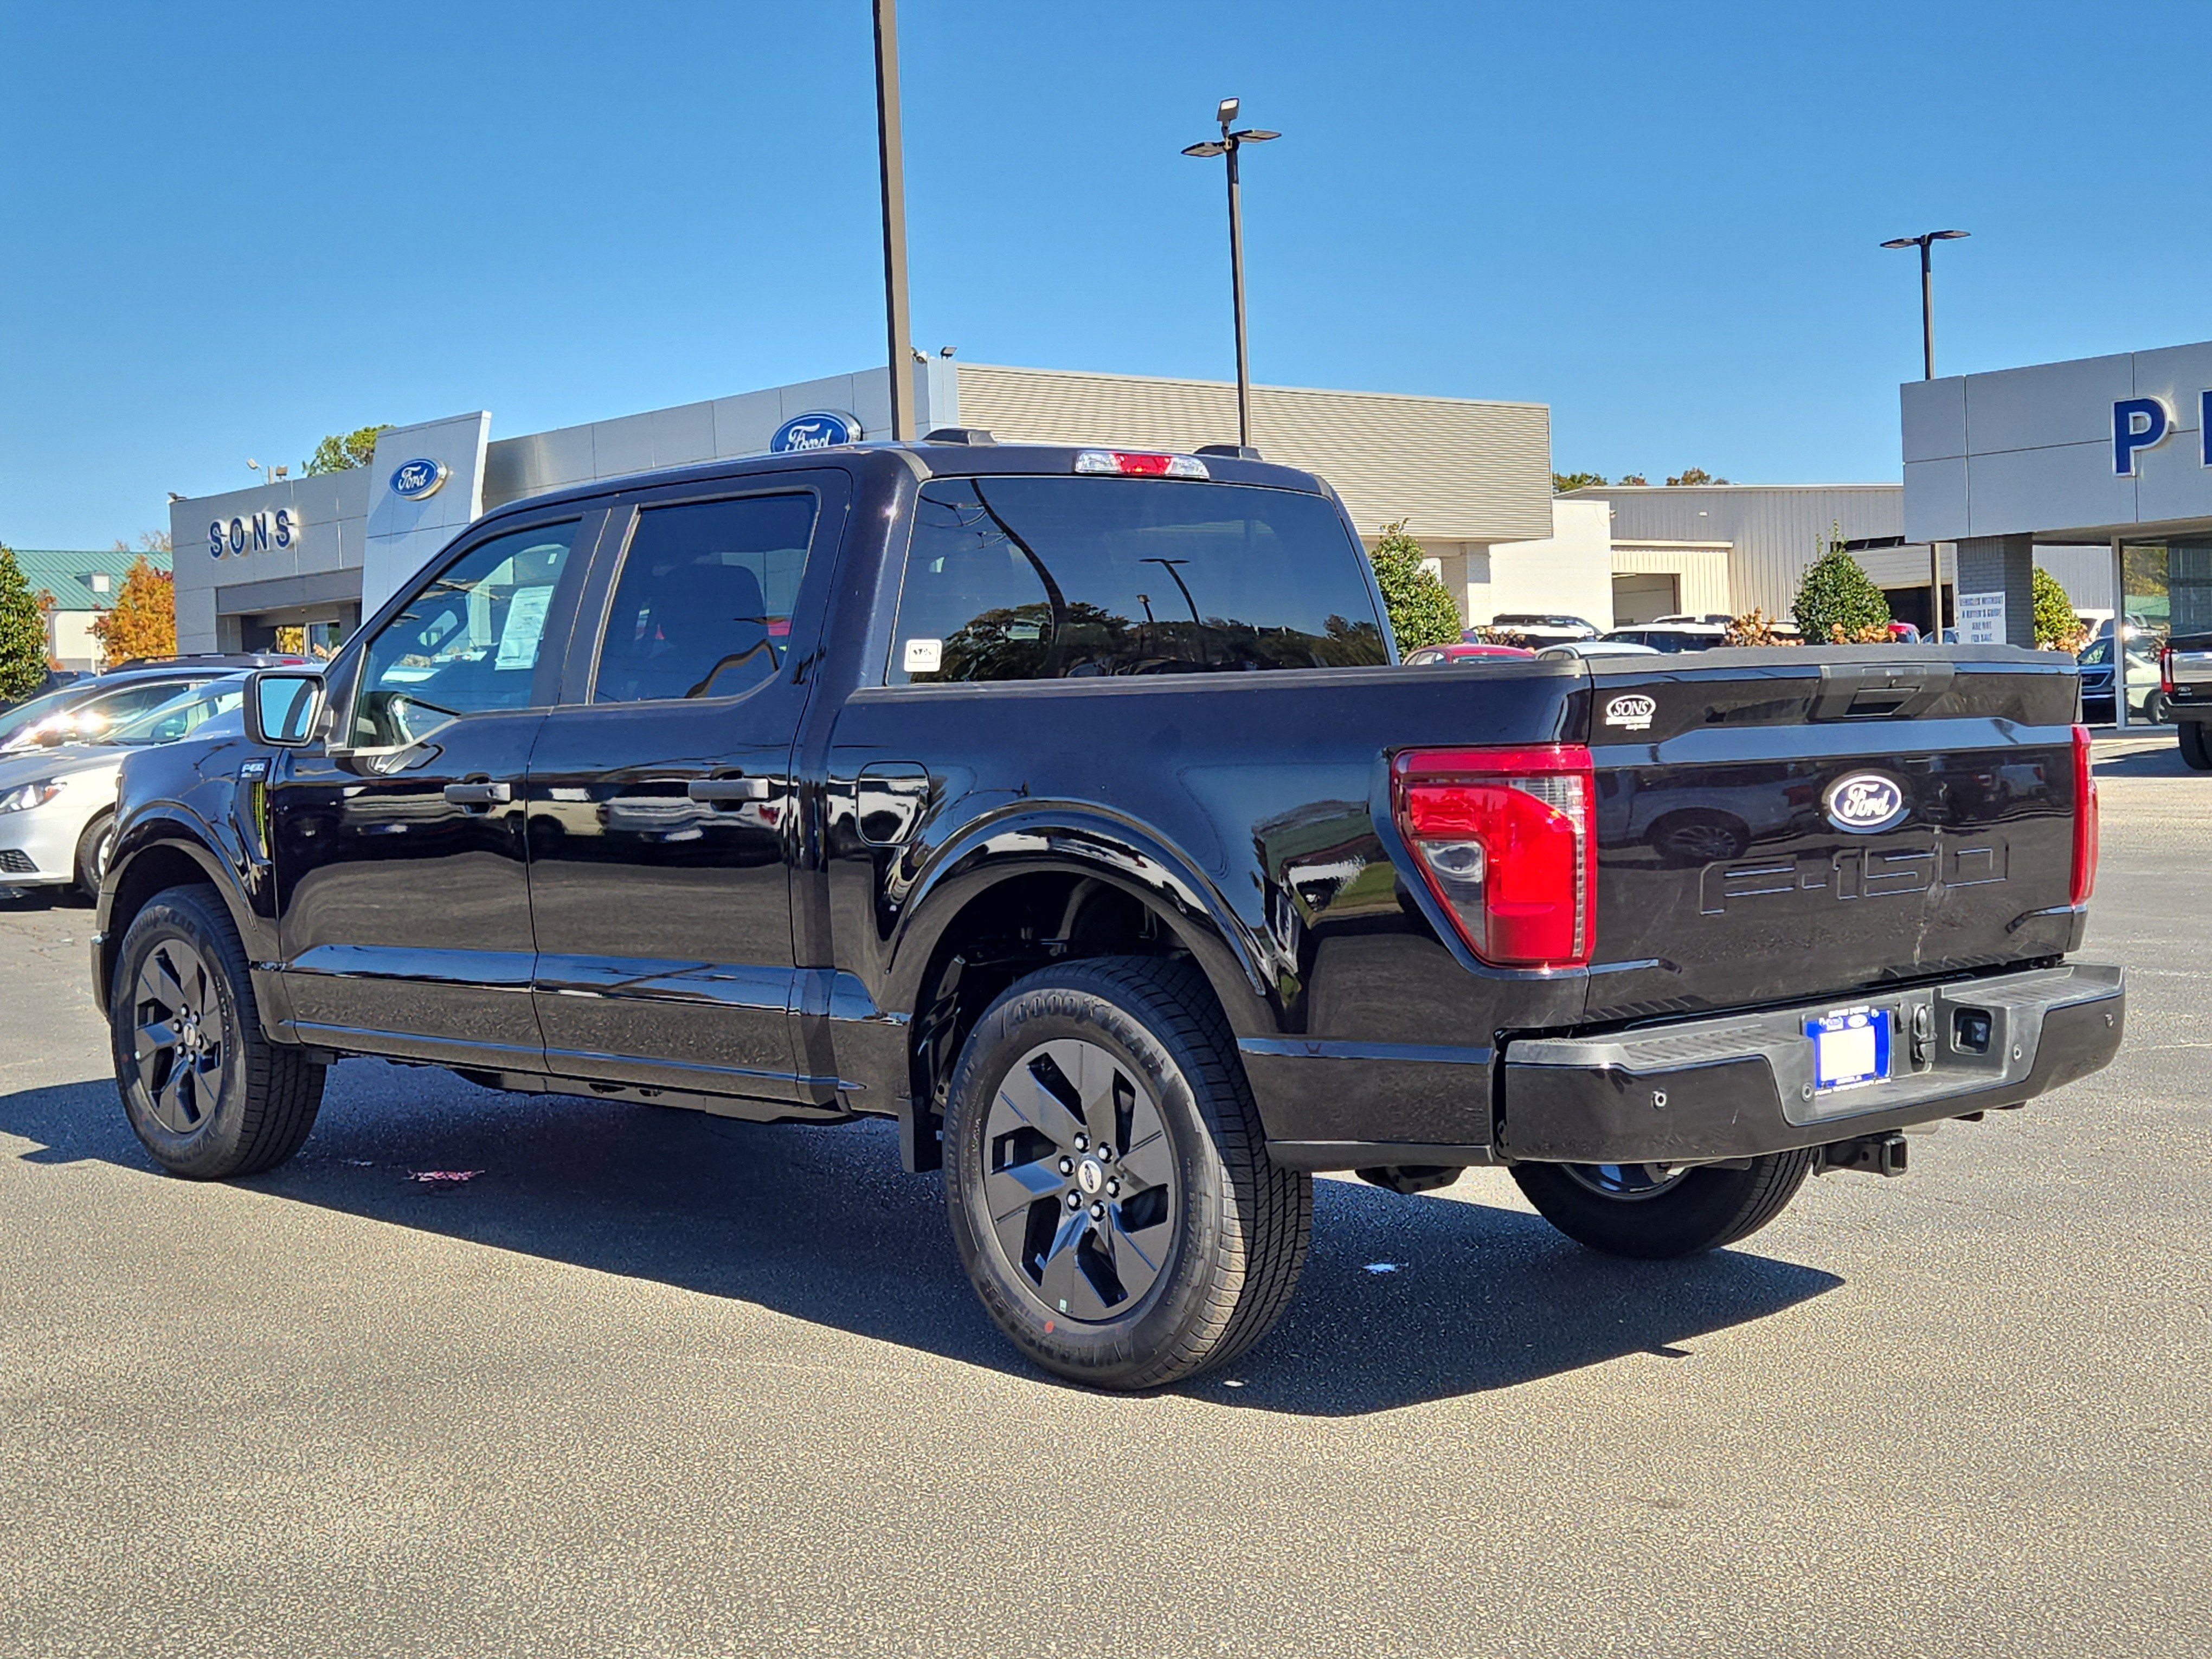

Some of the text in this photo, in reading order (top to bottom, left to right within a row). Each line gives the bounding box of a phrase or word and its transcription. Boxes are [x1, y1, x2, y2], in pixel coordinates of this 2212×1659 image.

[785, 423, 832, 452] Ford
[398, 465, 428, 491] Ford
[208, 509, 293, 560] SONS
[1613, 700, 1649, 716] SONS
[1843, 783, 1891, 817] Ford
[1700, 843, 2008, 915] F-150
